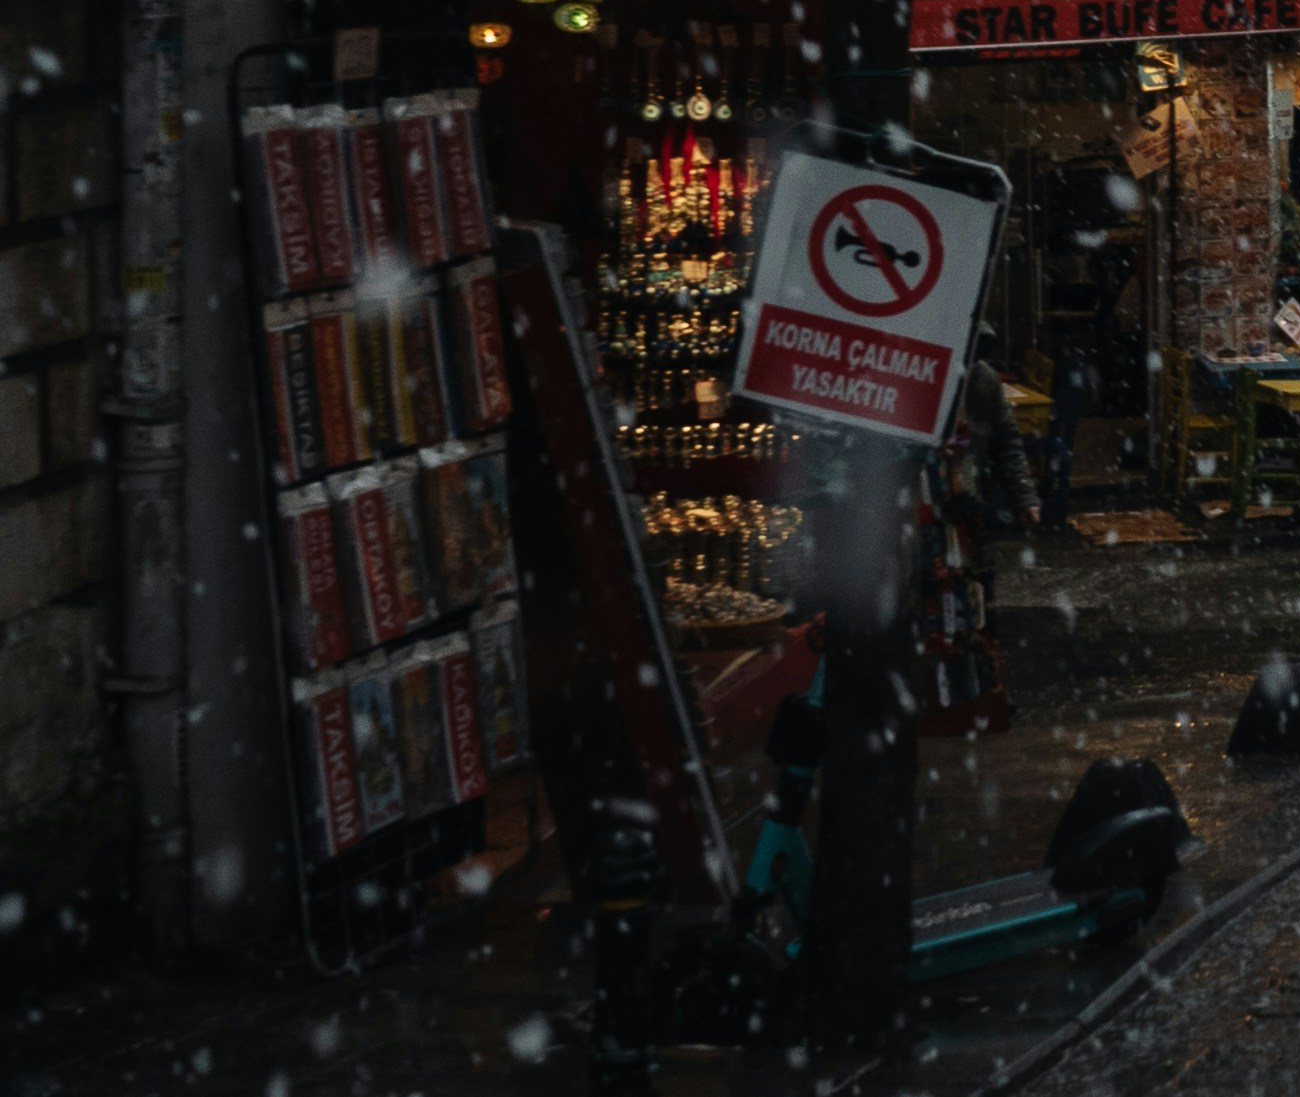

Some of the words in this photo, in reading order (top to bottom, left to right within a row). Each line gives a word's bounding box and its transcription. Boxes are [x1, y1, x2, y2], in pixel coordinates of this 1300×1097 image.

[955, 4, 1057, 44] STAR
[764, 319, 843, 361] KORNA
[847, 338, 940, 385] ÇALMAK
[791, 363, 899, 414] YASAKTIR
